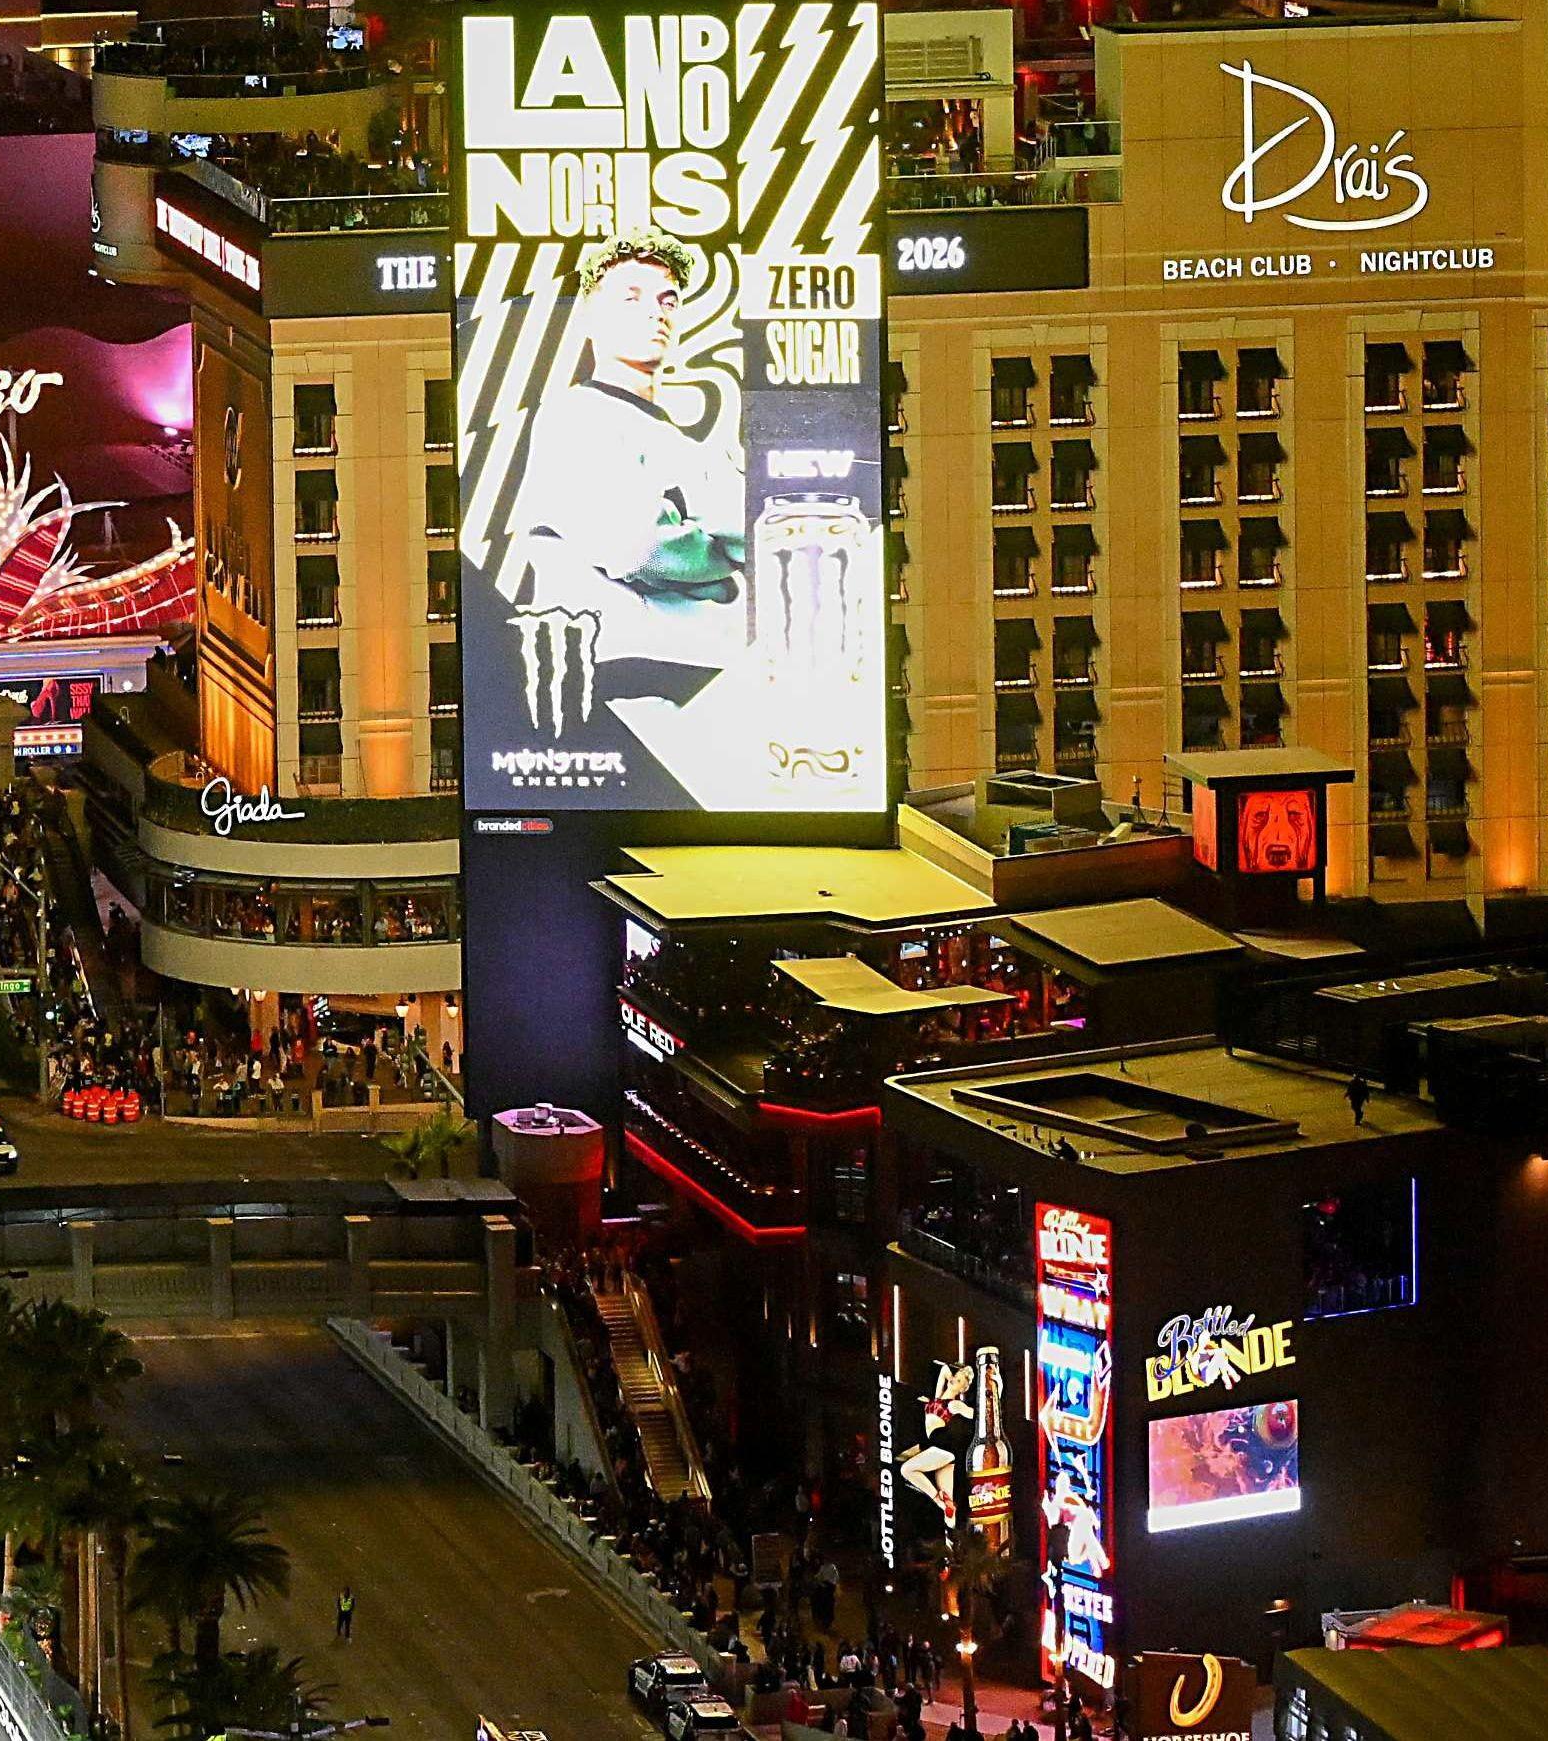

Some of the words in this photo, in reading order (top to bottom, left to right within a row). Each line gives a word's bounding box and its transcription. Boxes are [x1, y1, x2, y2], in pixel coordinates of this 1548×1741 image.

[462, 14, 731, 149] LANDO
[1220, 58, 1428, 231] Drai's
[465, 150, 732, 238] NORRIS
[377, 256, 436, 292] THE
[897, 237, 964, 271] 2026
[1163, 257, 1242, 281] BEACH
[1250, 254, 1312, 278] CLUB
[1360, 248, 1494, 273] NIGHTCLUB
[768, 265, 856, 310] ZERO
[766, 321, 860, 385] SUGAR
[767, 450, 856, 479] NEW
[70, 682, 94, 696] SISSY
[23, 746, 52, 756] ROLLER
[492, 748, 627, 773] MONSTER
[512, 776, 604, 787] ENERGY
[201, 777, 306, 835] Giada
[621, 1002, 647, 1036] OLE
[649, 1021, 675, 1056] RED
[1158, 1305, 1255, 1380] Bottled
[878, 1374, 893, 1464] BLONDE
